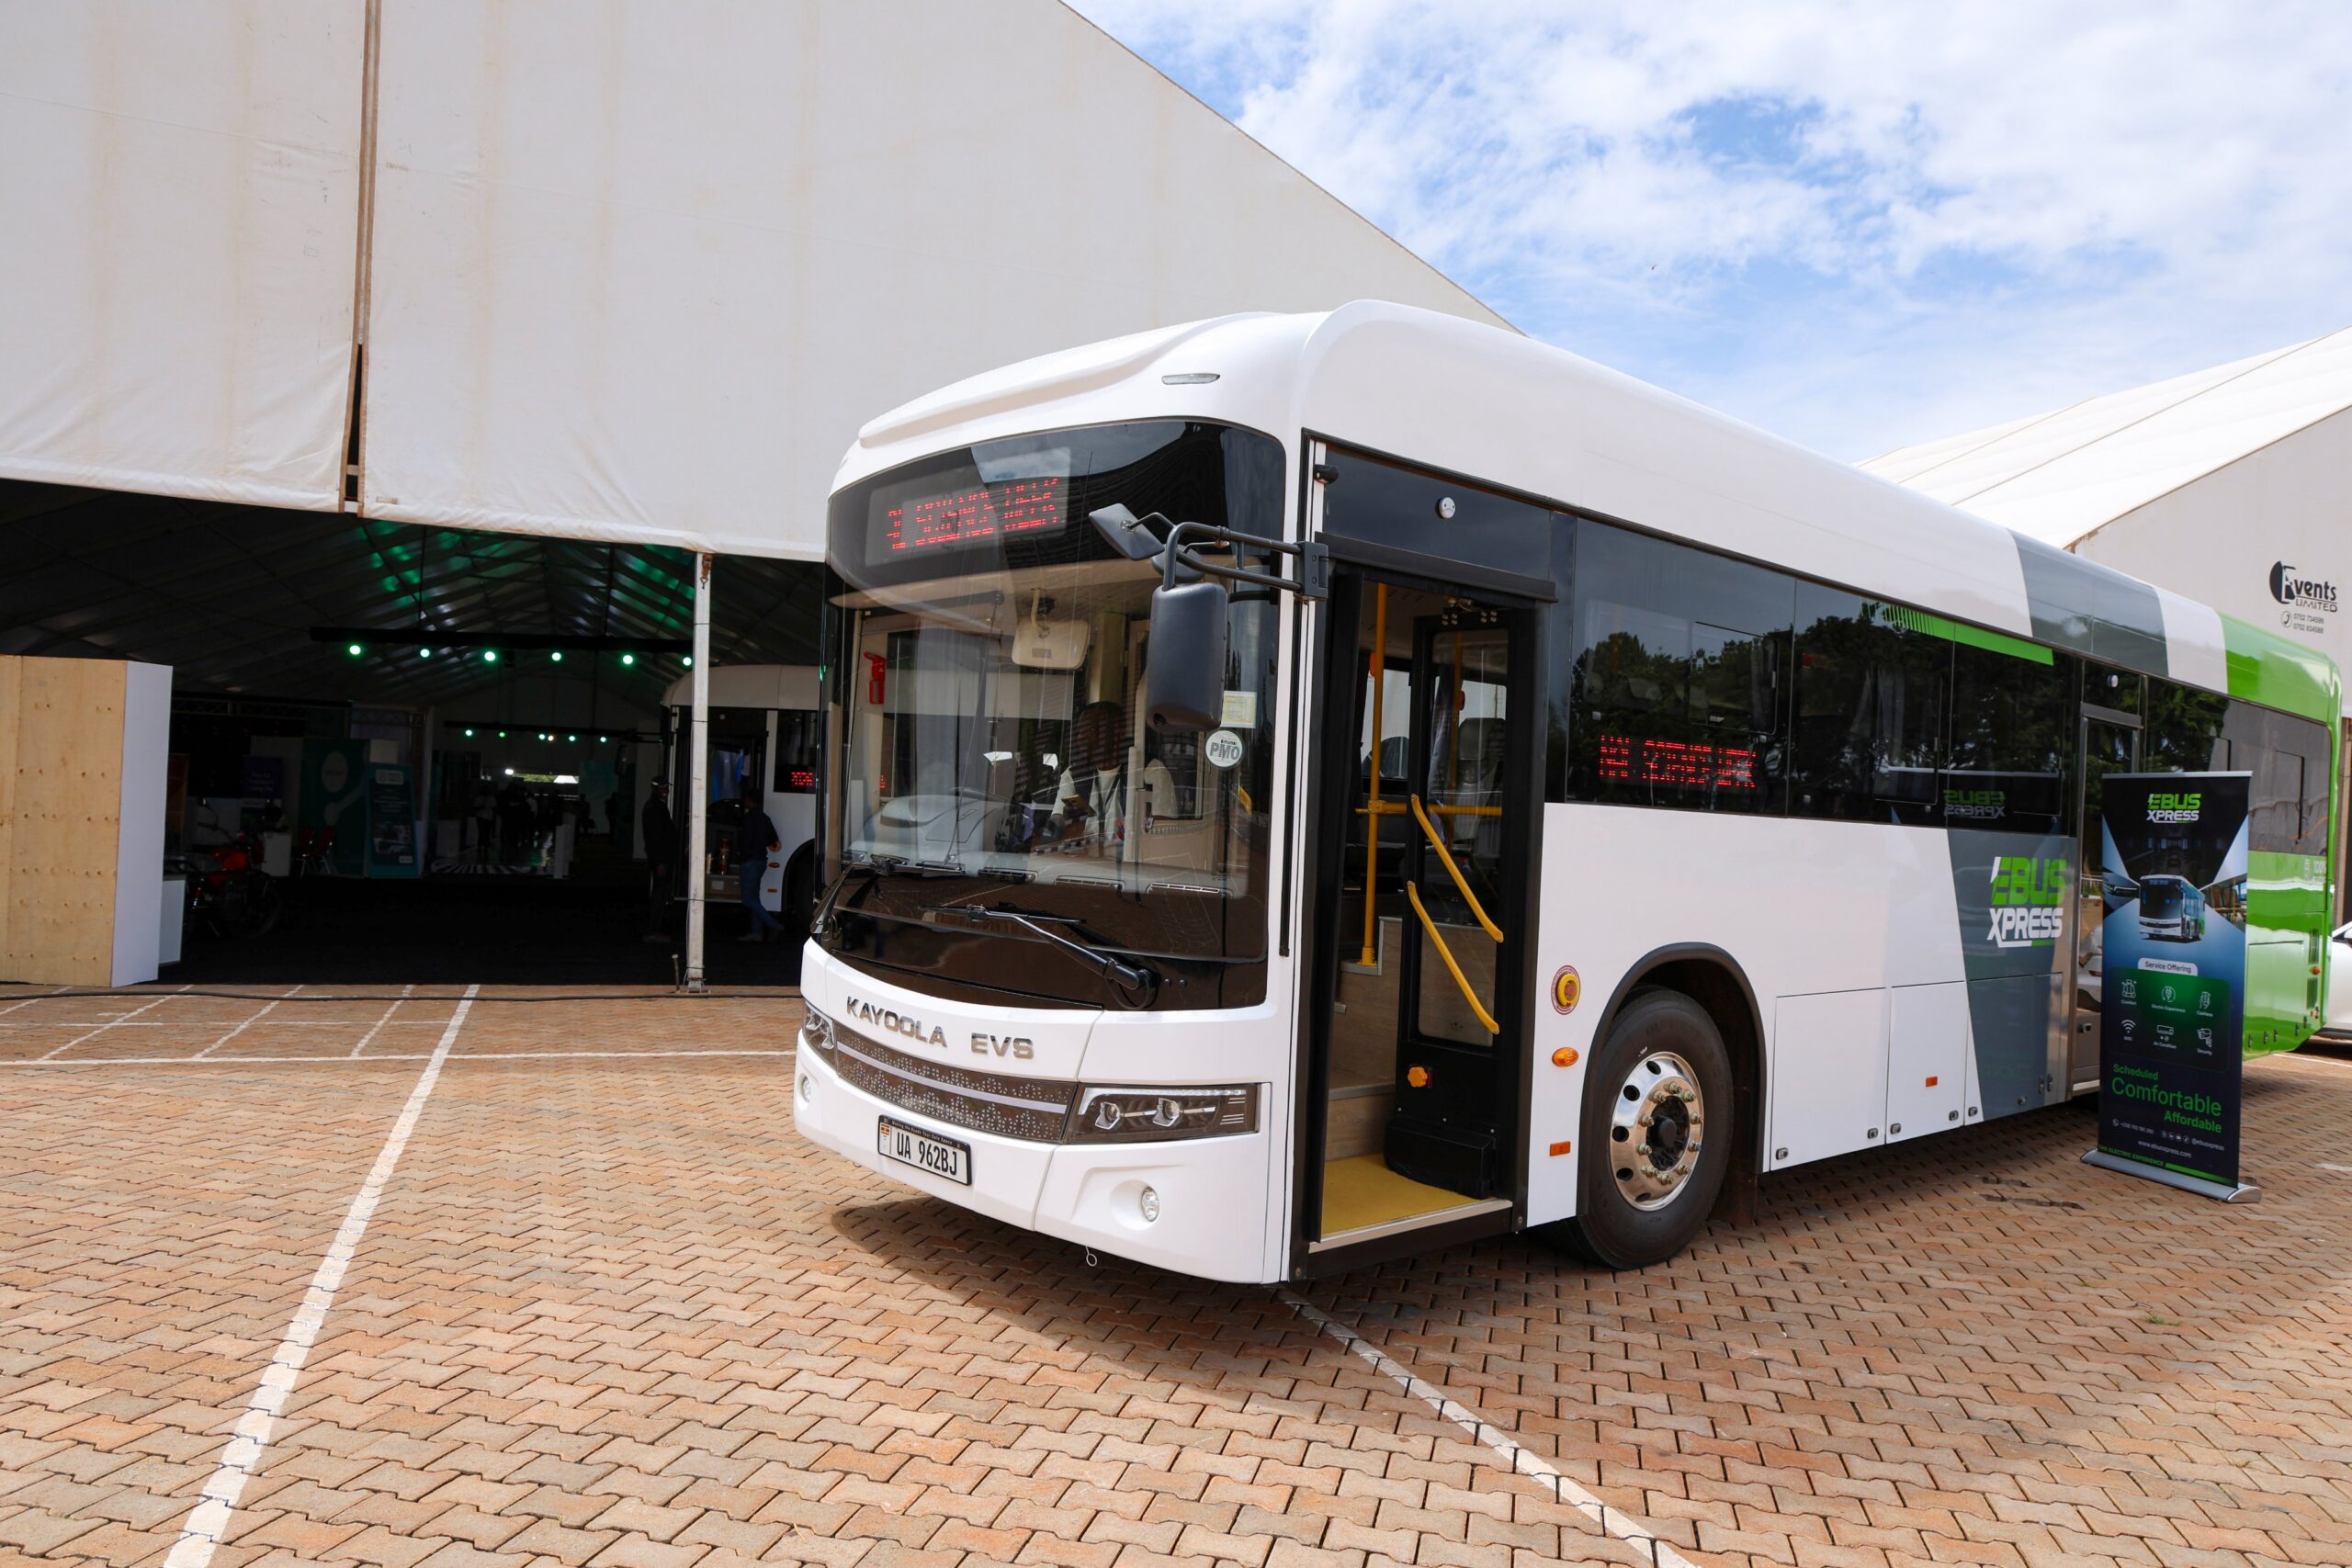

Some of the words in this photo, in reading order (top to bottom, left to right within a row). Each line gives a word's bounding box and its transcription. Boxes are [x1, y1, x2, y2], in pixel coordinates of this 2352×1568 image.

[2295, 599, 2337, 613] LIMITED
[1210, 742, 1240, 760] PMO
[2147, 794, 2201, 809] EBUS
[2146, 810, 2199, 823] XPRESS
[1990, 857, 2067, 906] EBUS
[1986, 908, 2064, 947] XPRESS
[2145, 961, 2165, 970] Service
[2166, 964, 2192, 974] Offering
[846, 996, 947, 1048] KAYOOLA
[971, 1032, 1035, 1059] EVS
[2113, 1064, 2158, 1080] Scheduled
[2112, 1077, 2222, 1117] Comfortable
[2164, 1111, 2222, 1134] Affordable
[897, 1132, 911, 1159] UA
[919, 1140, 957, 1175] 962BJ
